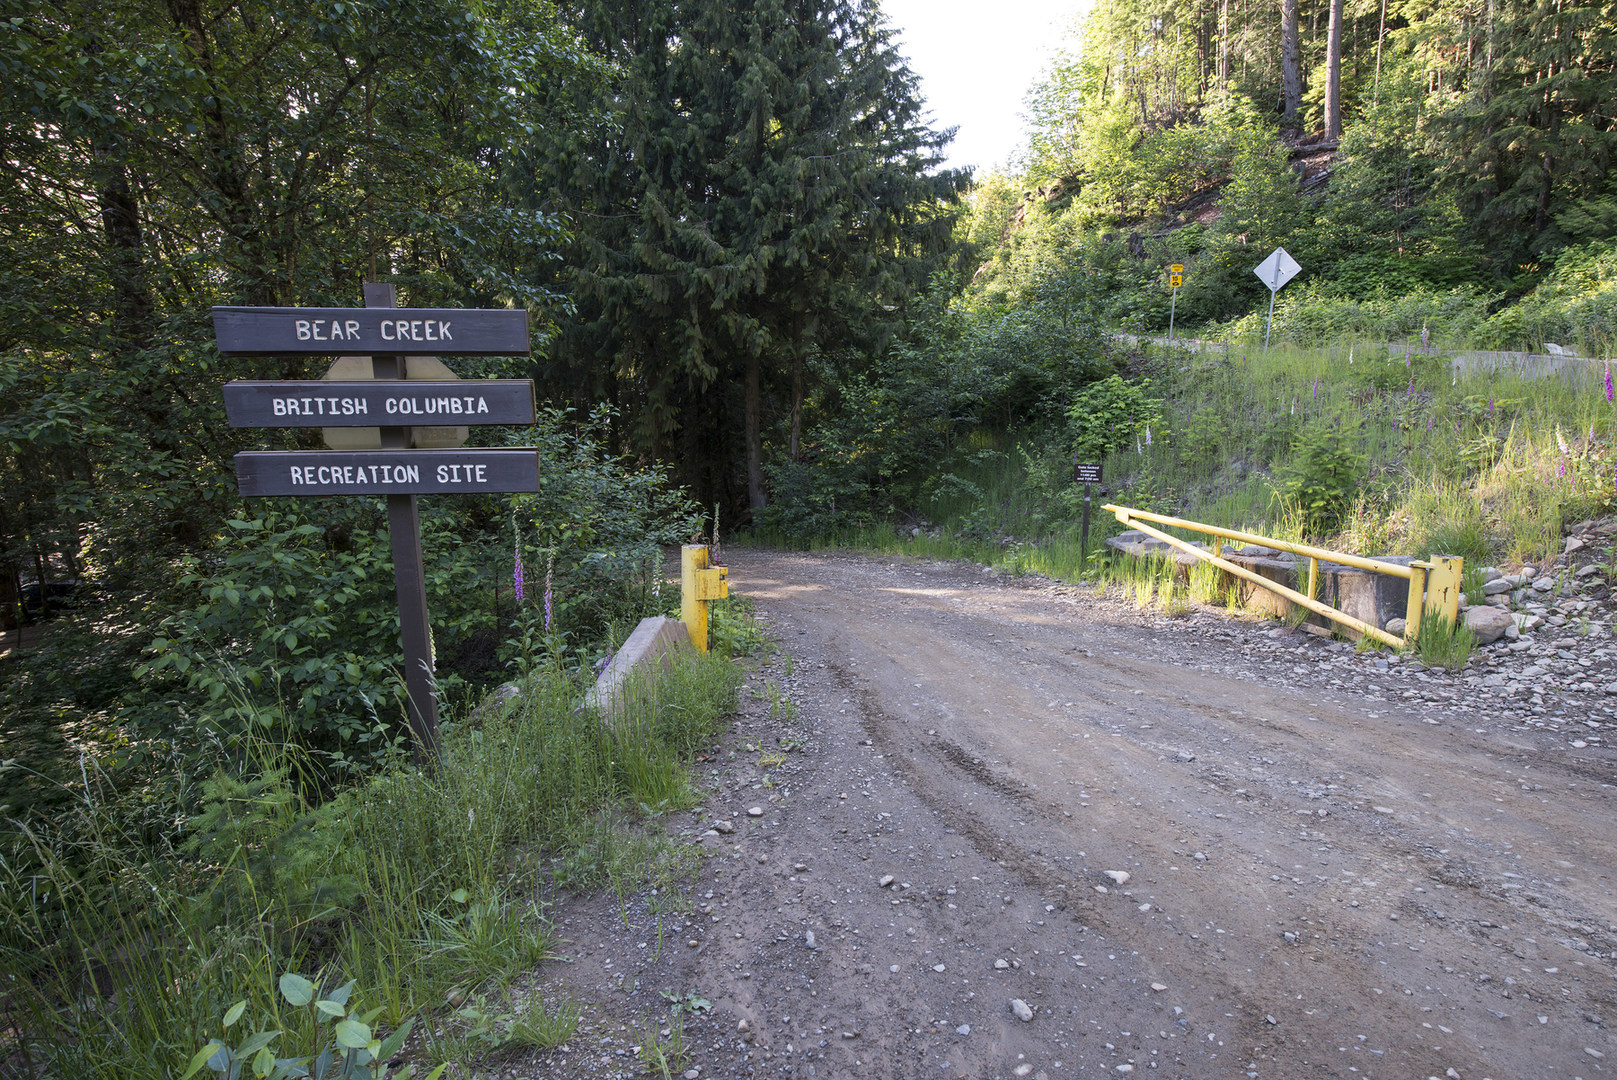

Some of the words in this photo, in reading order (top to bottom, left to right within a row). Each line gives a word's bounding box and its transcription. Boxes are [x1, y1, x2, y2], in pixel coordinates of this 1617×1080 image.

[295, 319, 361, 341] BEAR
[380, 319, 453, 341] CREEK
[272, 397, 368, 416] BRITISH
[385, 396, 489, 415] COLUMBIA
[290, 464, 420, 484] RECREATION
[436, 464, 488, 484] SITE
